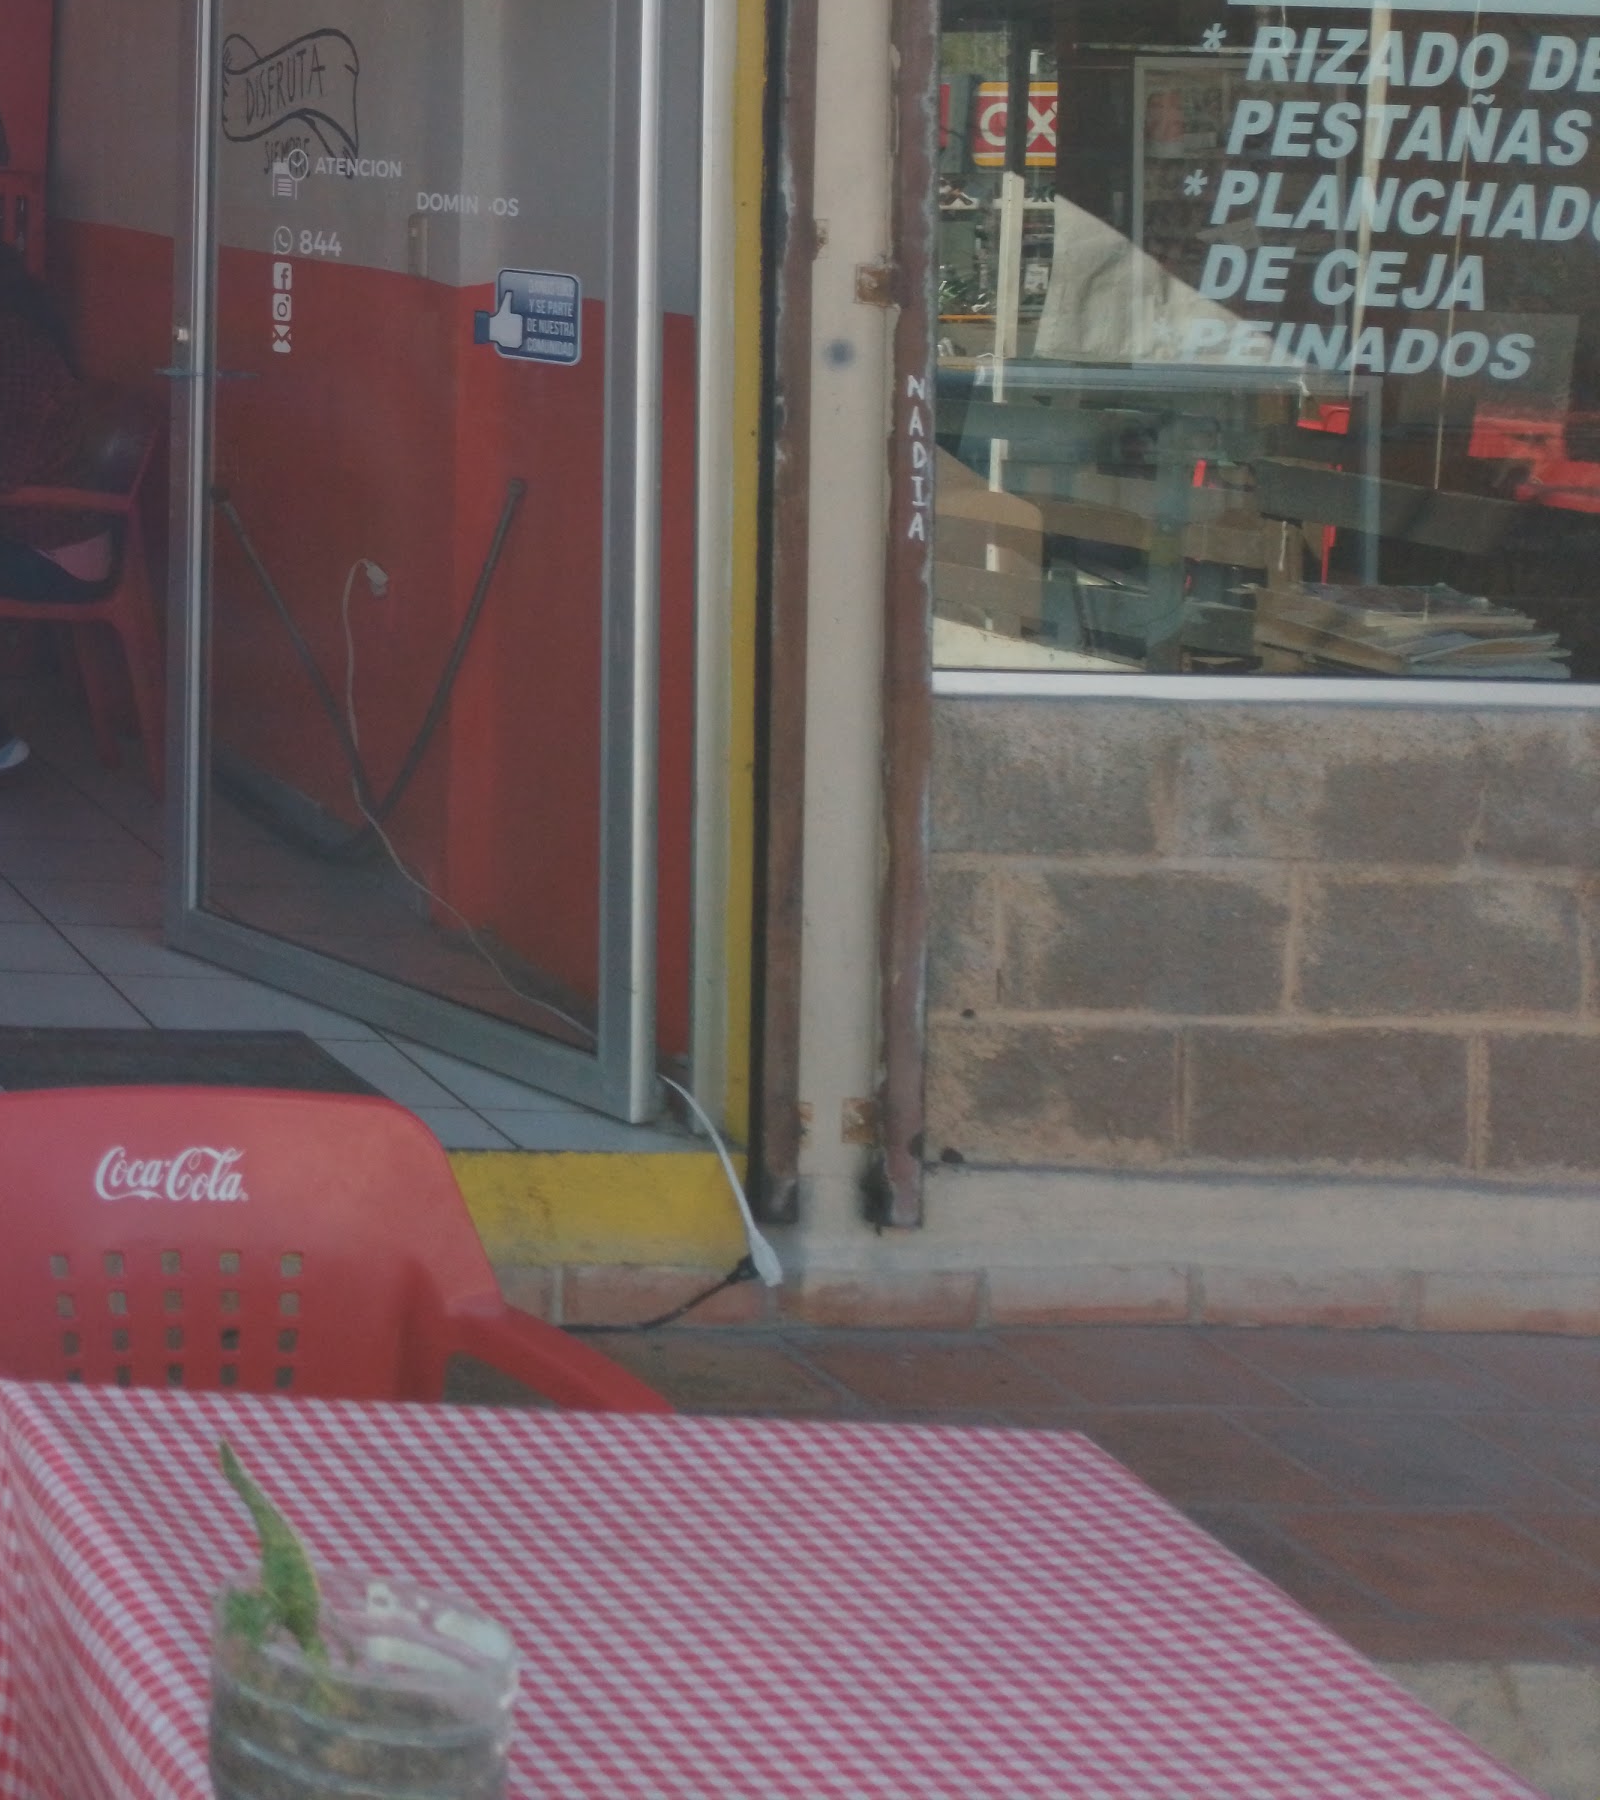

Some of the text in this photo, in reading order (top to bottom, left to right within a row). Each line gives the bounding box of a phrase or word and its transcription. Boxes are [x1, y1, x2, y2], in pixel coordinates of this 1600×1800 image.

[243, 46, 327, 127] DISFRUTA
[1247, 28, 1600, 94] RIZADO DE
[1227, 96, 1590, 167] PESTAÑAS
[315, 157, 402, 179] ATENCION
[416, 192, 520, 217] DOMINOS
[299, 229, 343, 257] 844
[1202, 244, 1486, 312] DE CEJA
[539, 319, 574, 337] NUESTRA
[1177, 318, 1535, 382] PEINADOS
[905, 375, 926, 542] NADIA
[94, 1146, 250, 1202] Coca-Cola
